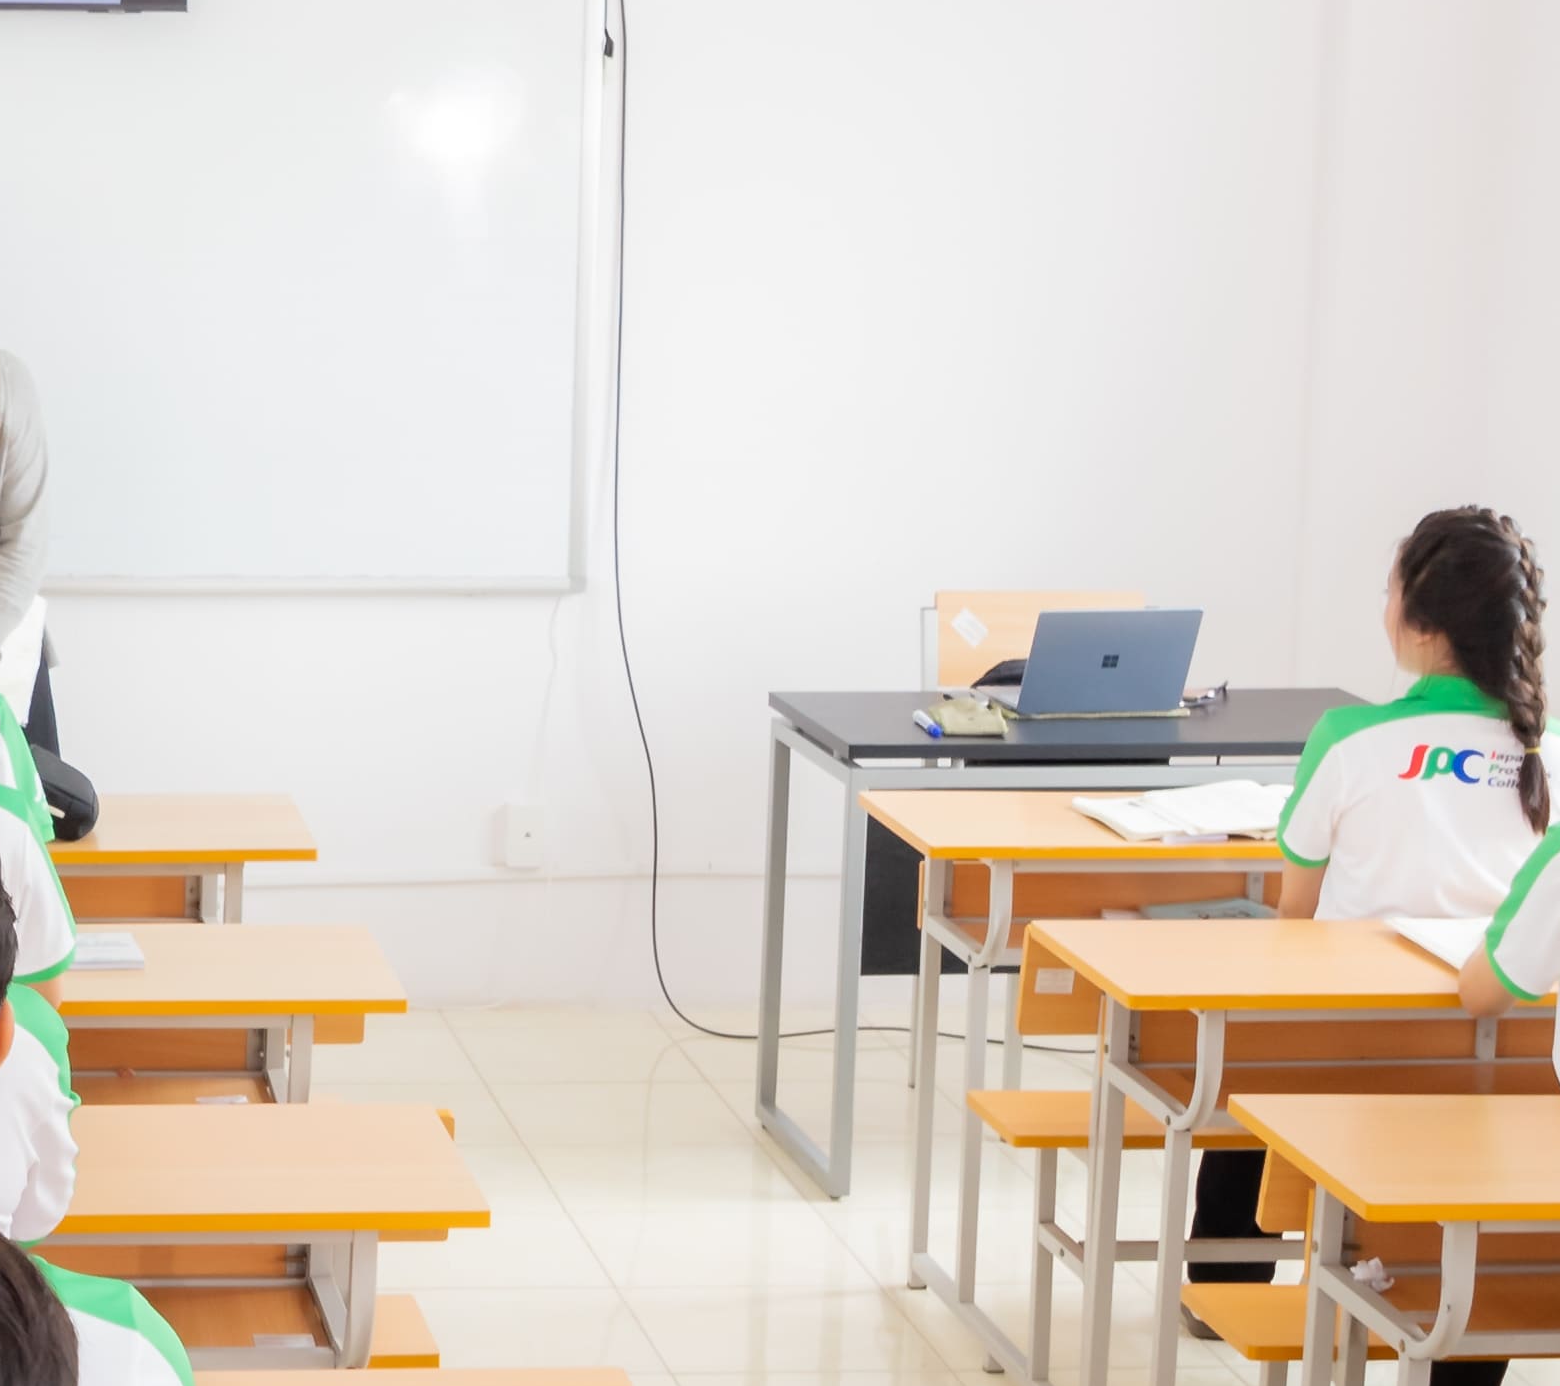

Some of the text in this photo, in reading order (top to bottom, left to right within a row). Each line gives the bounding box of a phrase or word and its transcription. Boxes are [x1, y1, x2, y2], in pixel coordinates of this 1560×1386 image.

[1398, 744, 1485, 784] JPC
[1489, 750, 1524, 764] Japa
[1487, 777, 1520, 789] Coll
